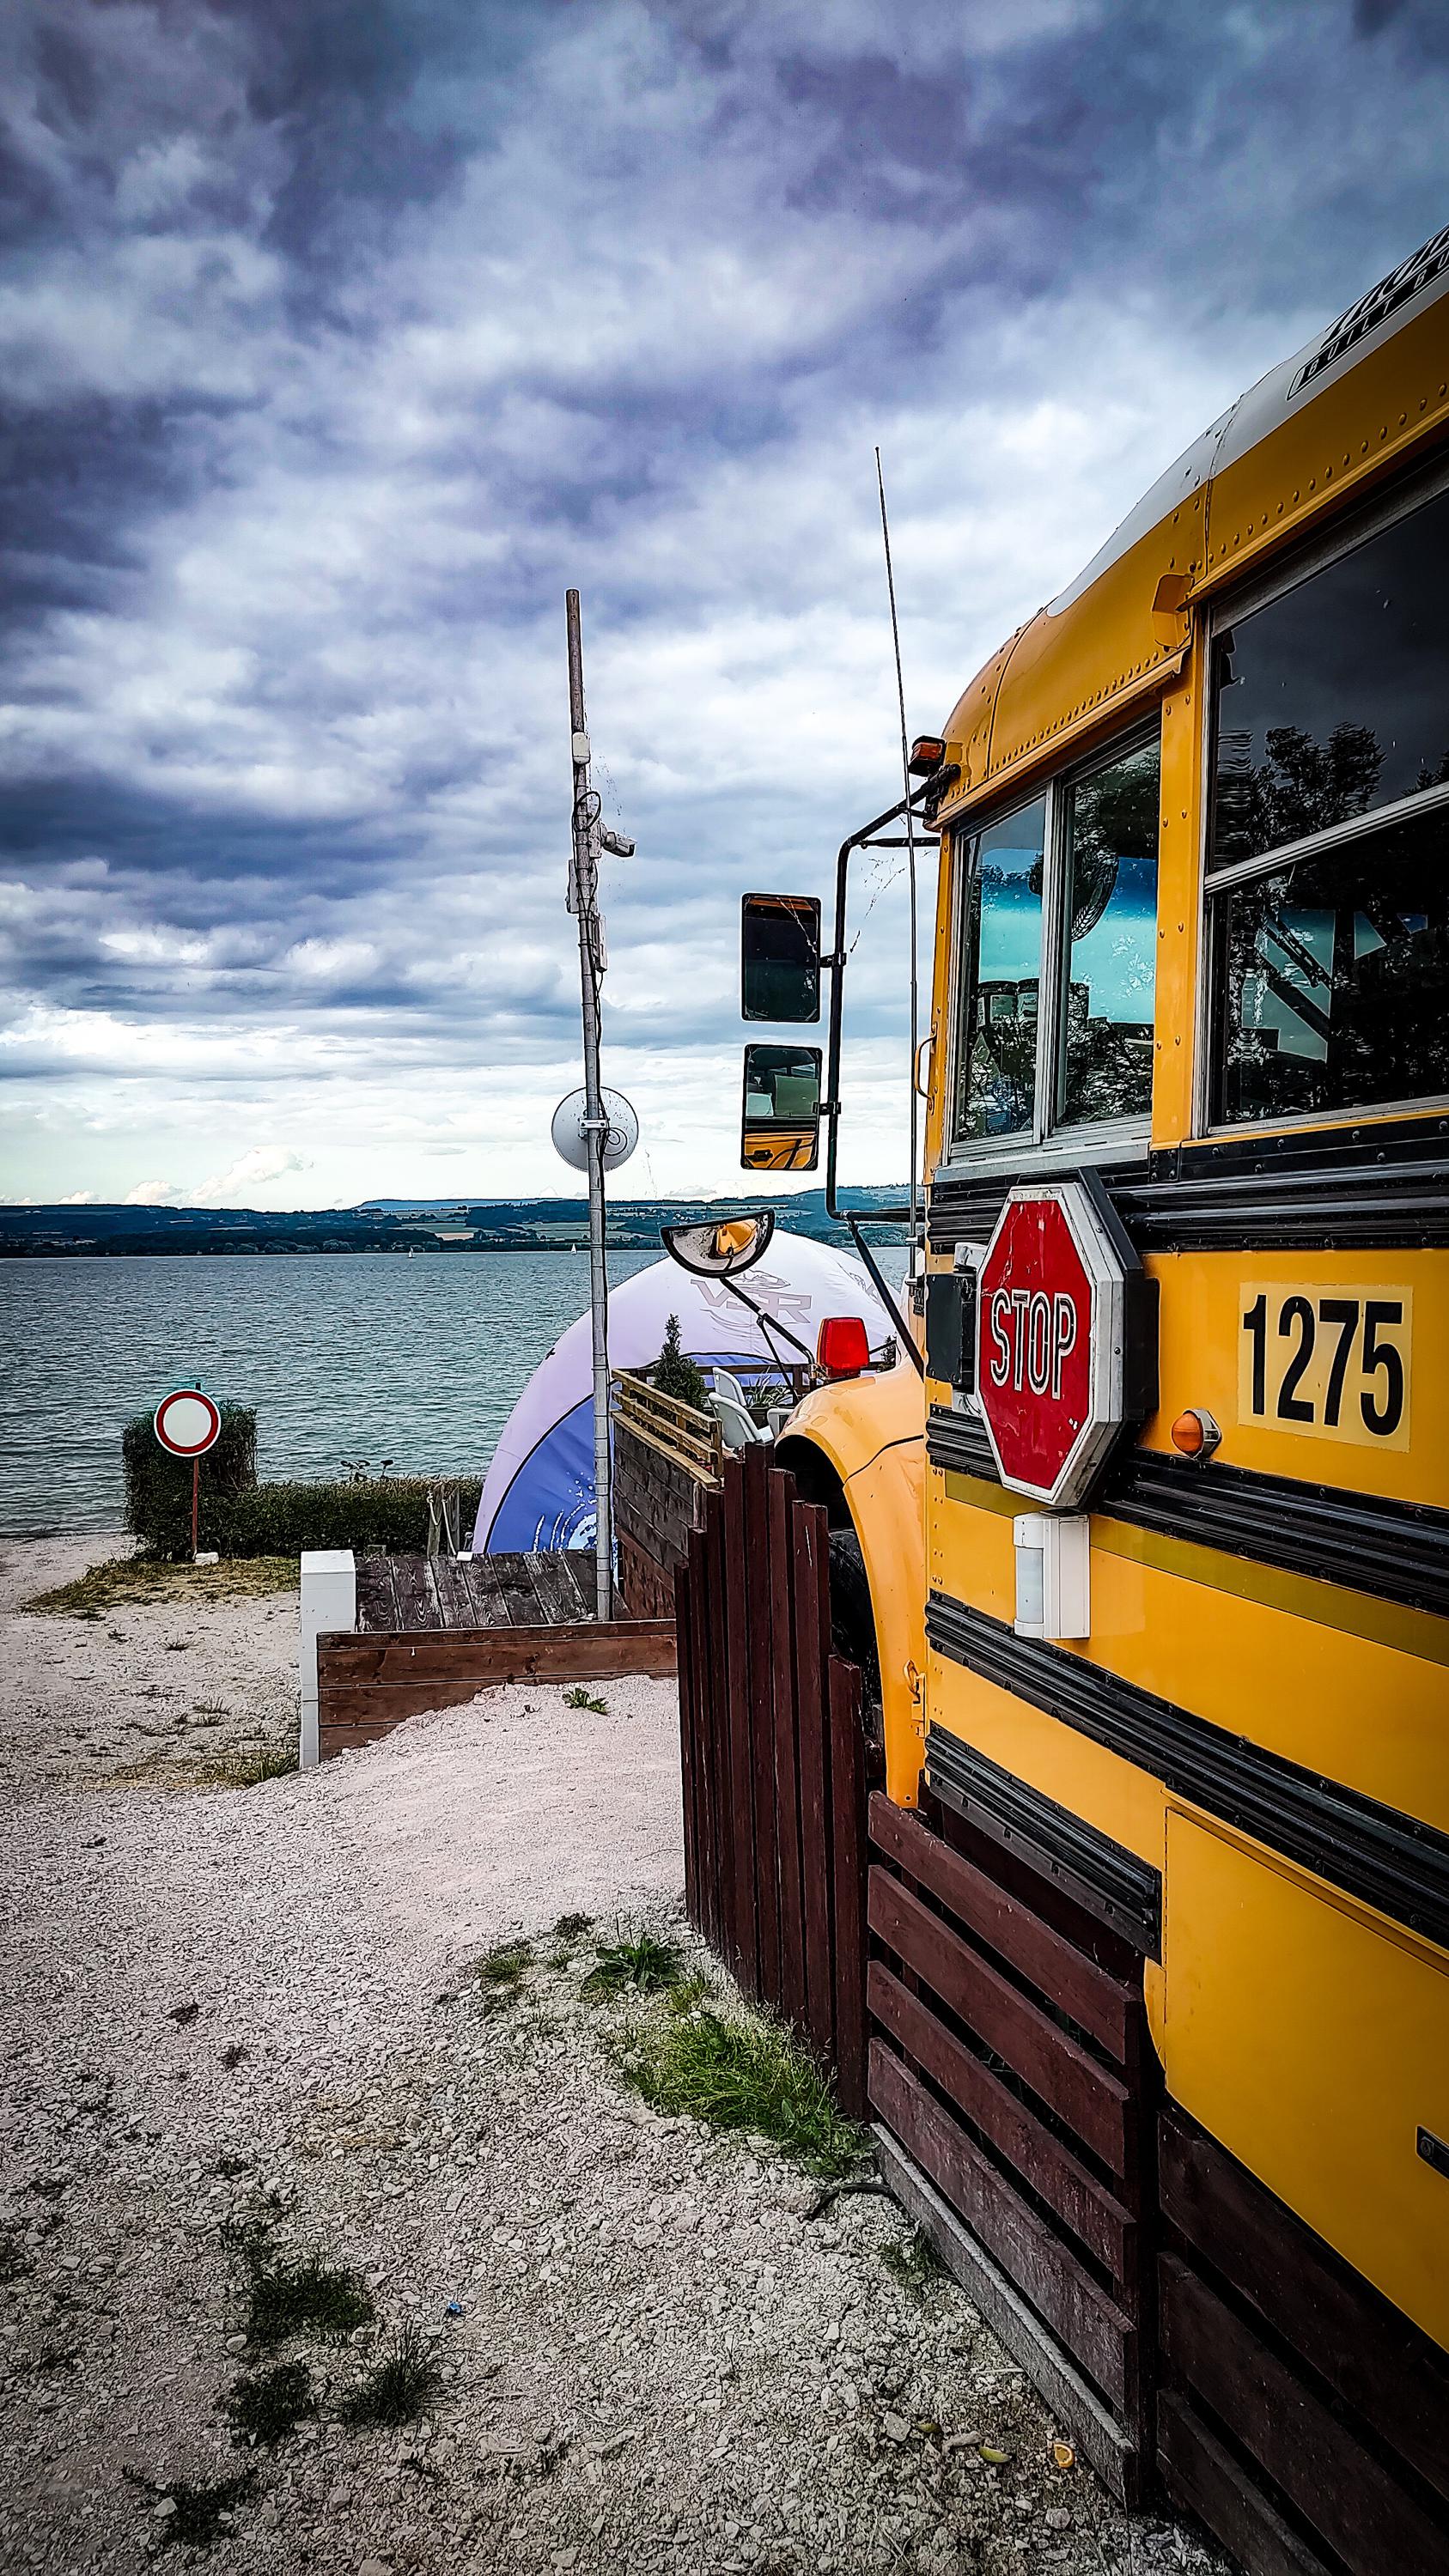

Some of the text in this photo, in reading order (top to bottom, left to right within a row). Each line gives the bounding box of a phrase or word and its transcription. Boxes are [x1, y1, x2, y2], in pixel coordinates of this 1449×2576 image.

[1307, 296, 1394, 378] BUILT
[990, 1288, 1077, 1400] STOP
[1243, 1294, 1404, 1436] 1275
